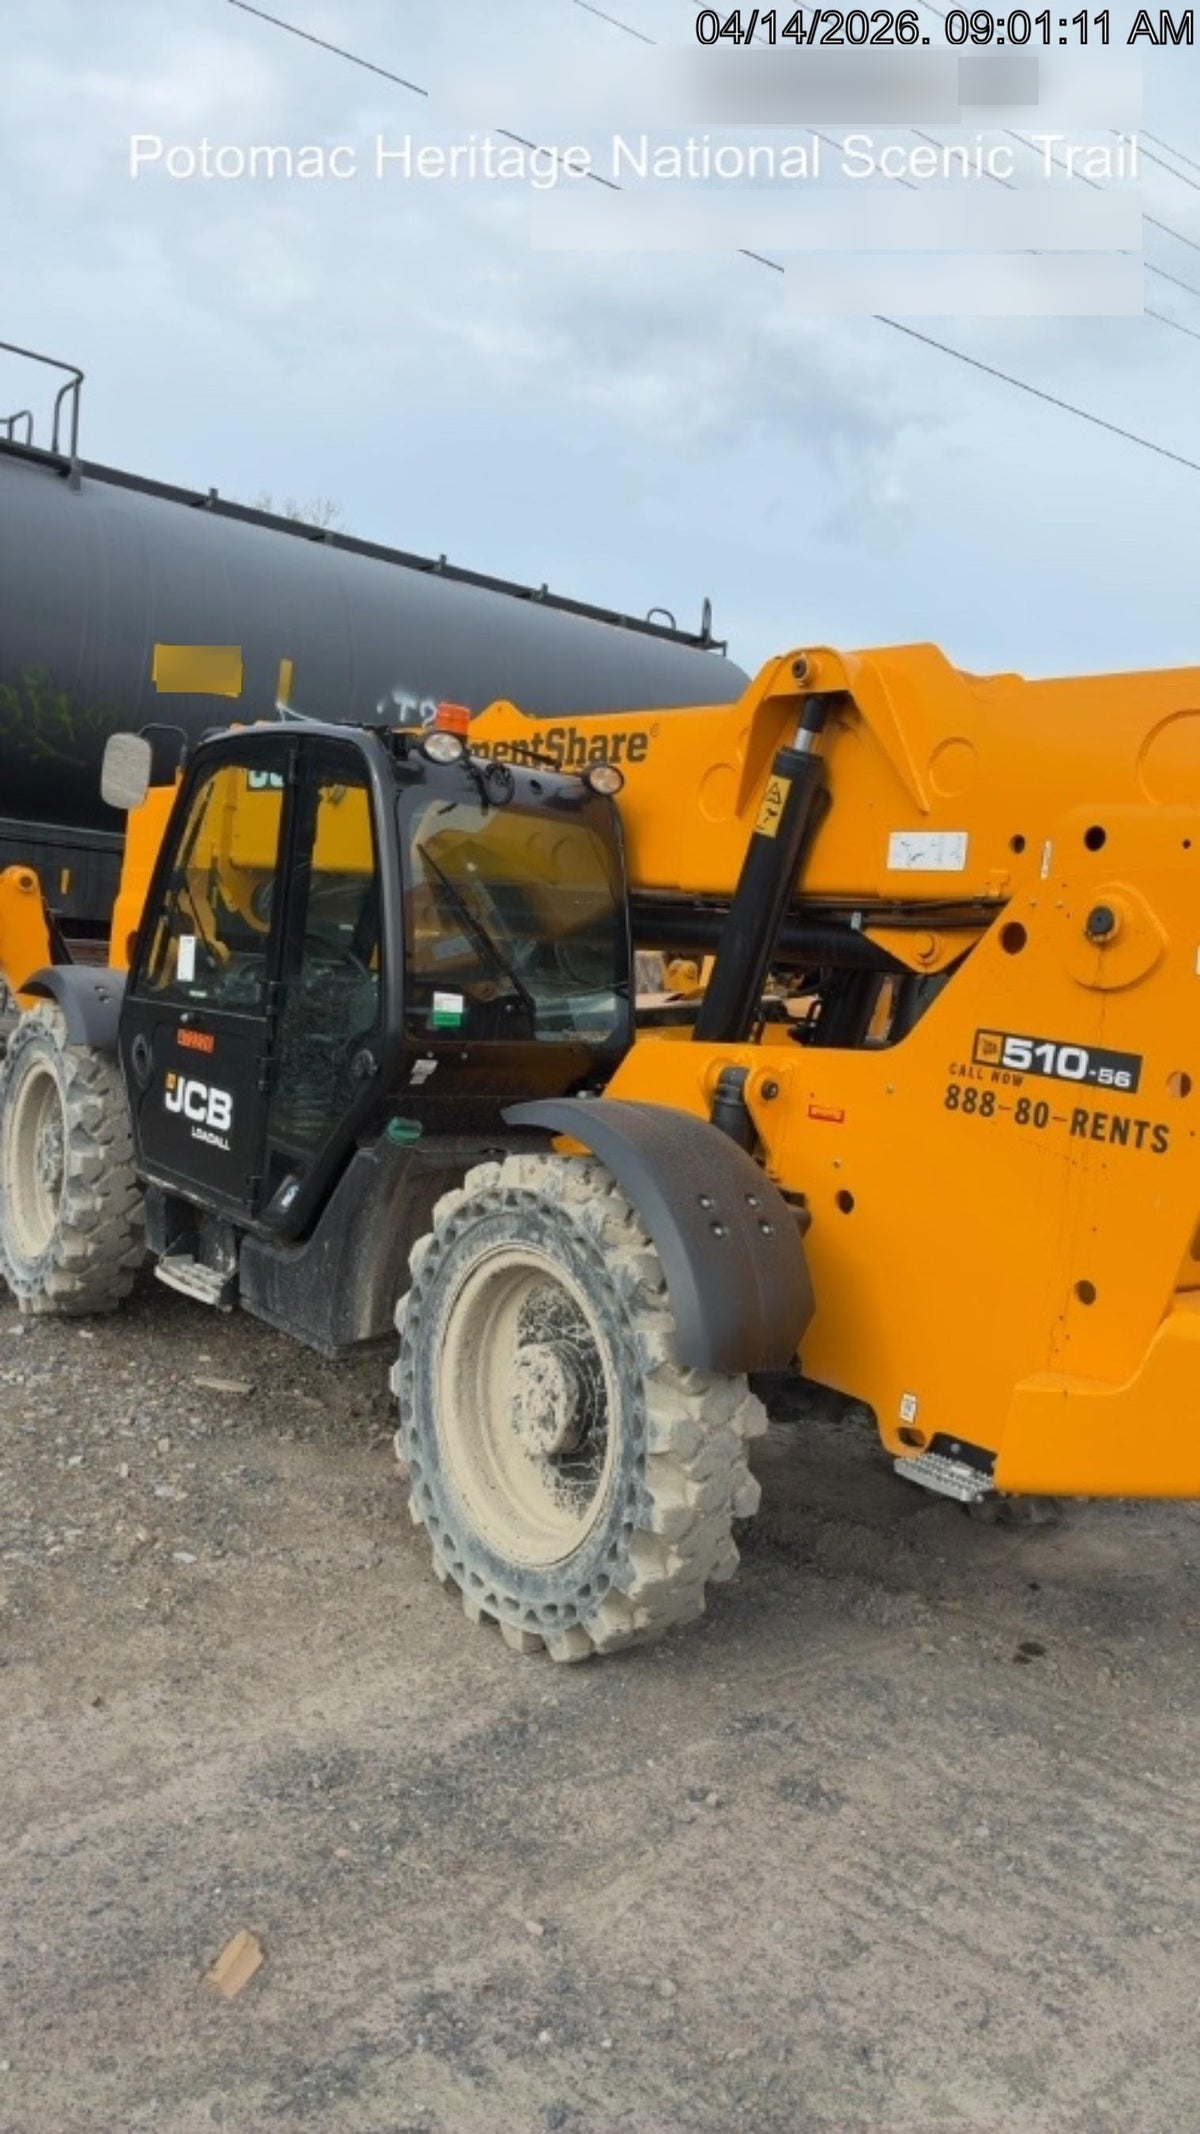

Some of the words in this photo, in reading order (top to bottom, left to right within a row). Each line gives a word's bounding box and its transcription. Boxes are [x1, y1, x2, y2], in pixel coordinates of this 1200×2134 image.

[165, 1074, 233, 1131] JCB
[950, 1063, 984, 1080] CALL
[991, 1070, 1024, 1087] NOW
[944, 1083, 1170, 1154] 888-80-RENTS
